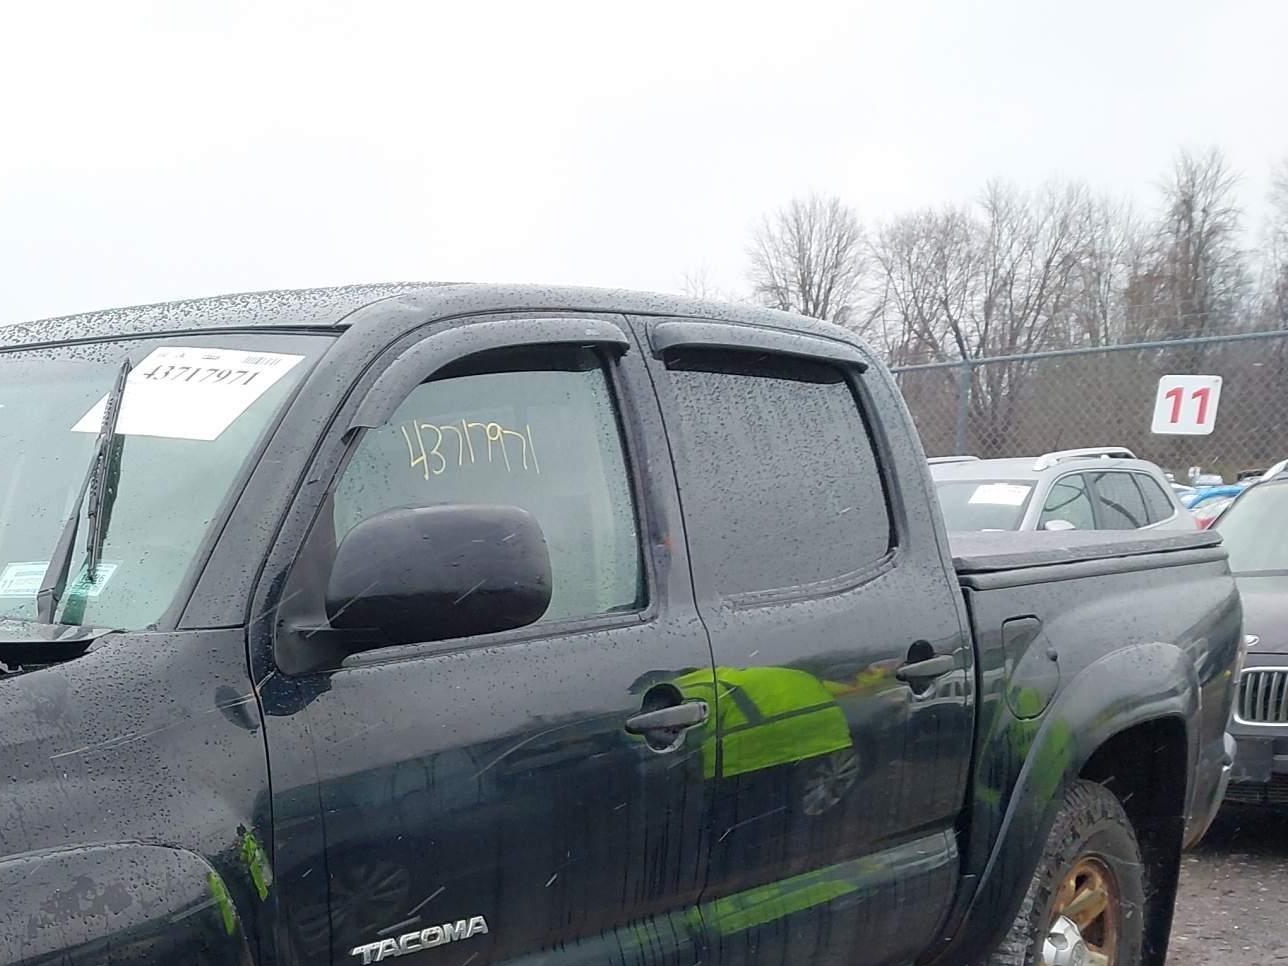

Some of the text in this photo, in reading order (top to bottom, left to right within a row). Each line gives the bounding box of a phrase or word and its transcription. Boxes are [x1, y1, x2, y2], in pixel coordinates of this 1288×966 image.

[143, 364, 261, 386] 43717971
[1165, 387, 1211, 425] 11
[401, 418, 540, 480] 43717971
[349, 915, 489, 965] TACOMA
